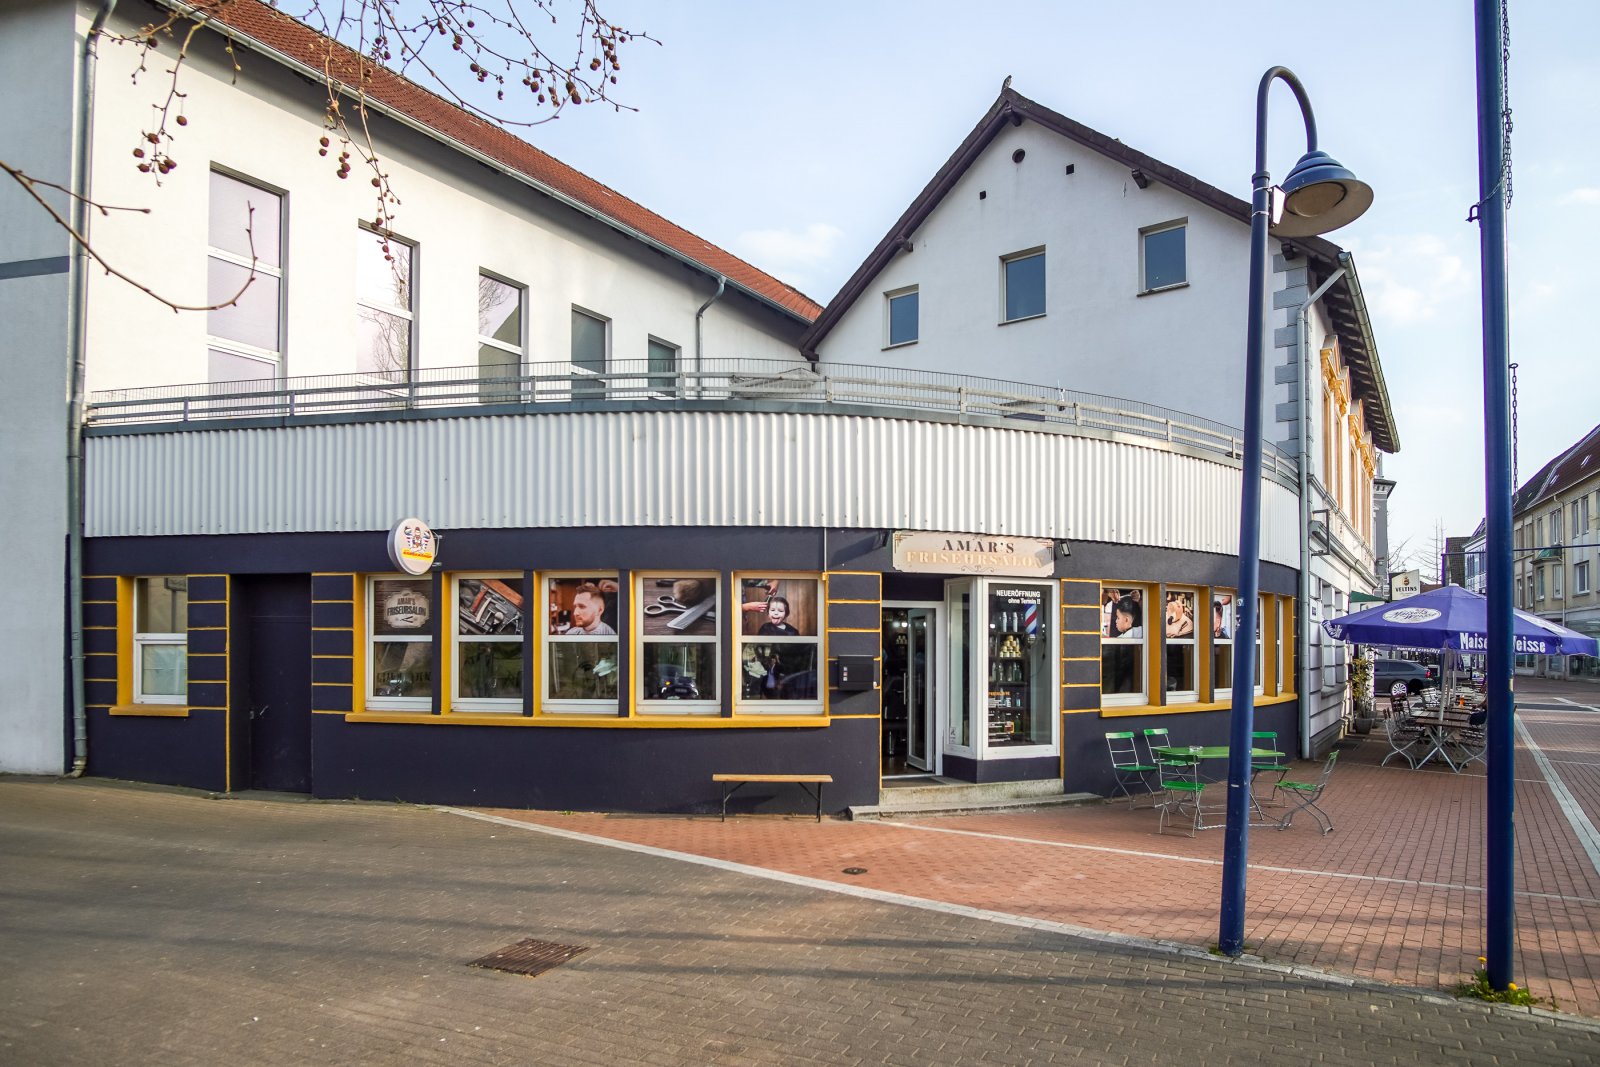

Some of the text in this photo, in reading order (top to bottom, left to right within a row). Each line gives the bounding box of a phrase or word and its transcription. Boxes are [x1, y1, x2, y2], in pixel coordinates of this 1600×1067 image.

[942, 539, 1014, 554] AMAR'S
[906, 551, 1041, 568] FRISEURSALON
[996, 589, 1041, 598] NEUERÖFFNUNG
[1513, 635, 1546, 653] eisse
